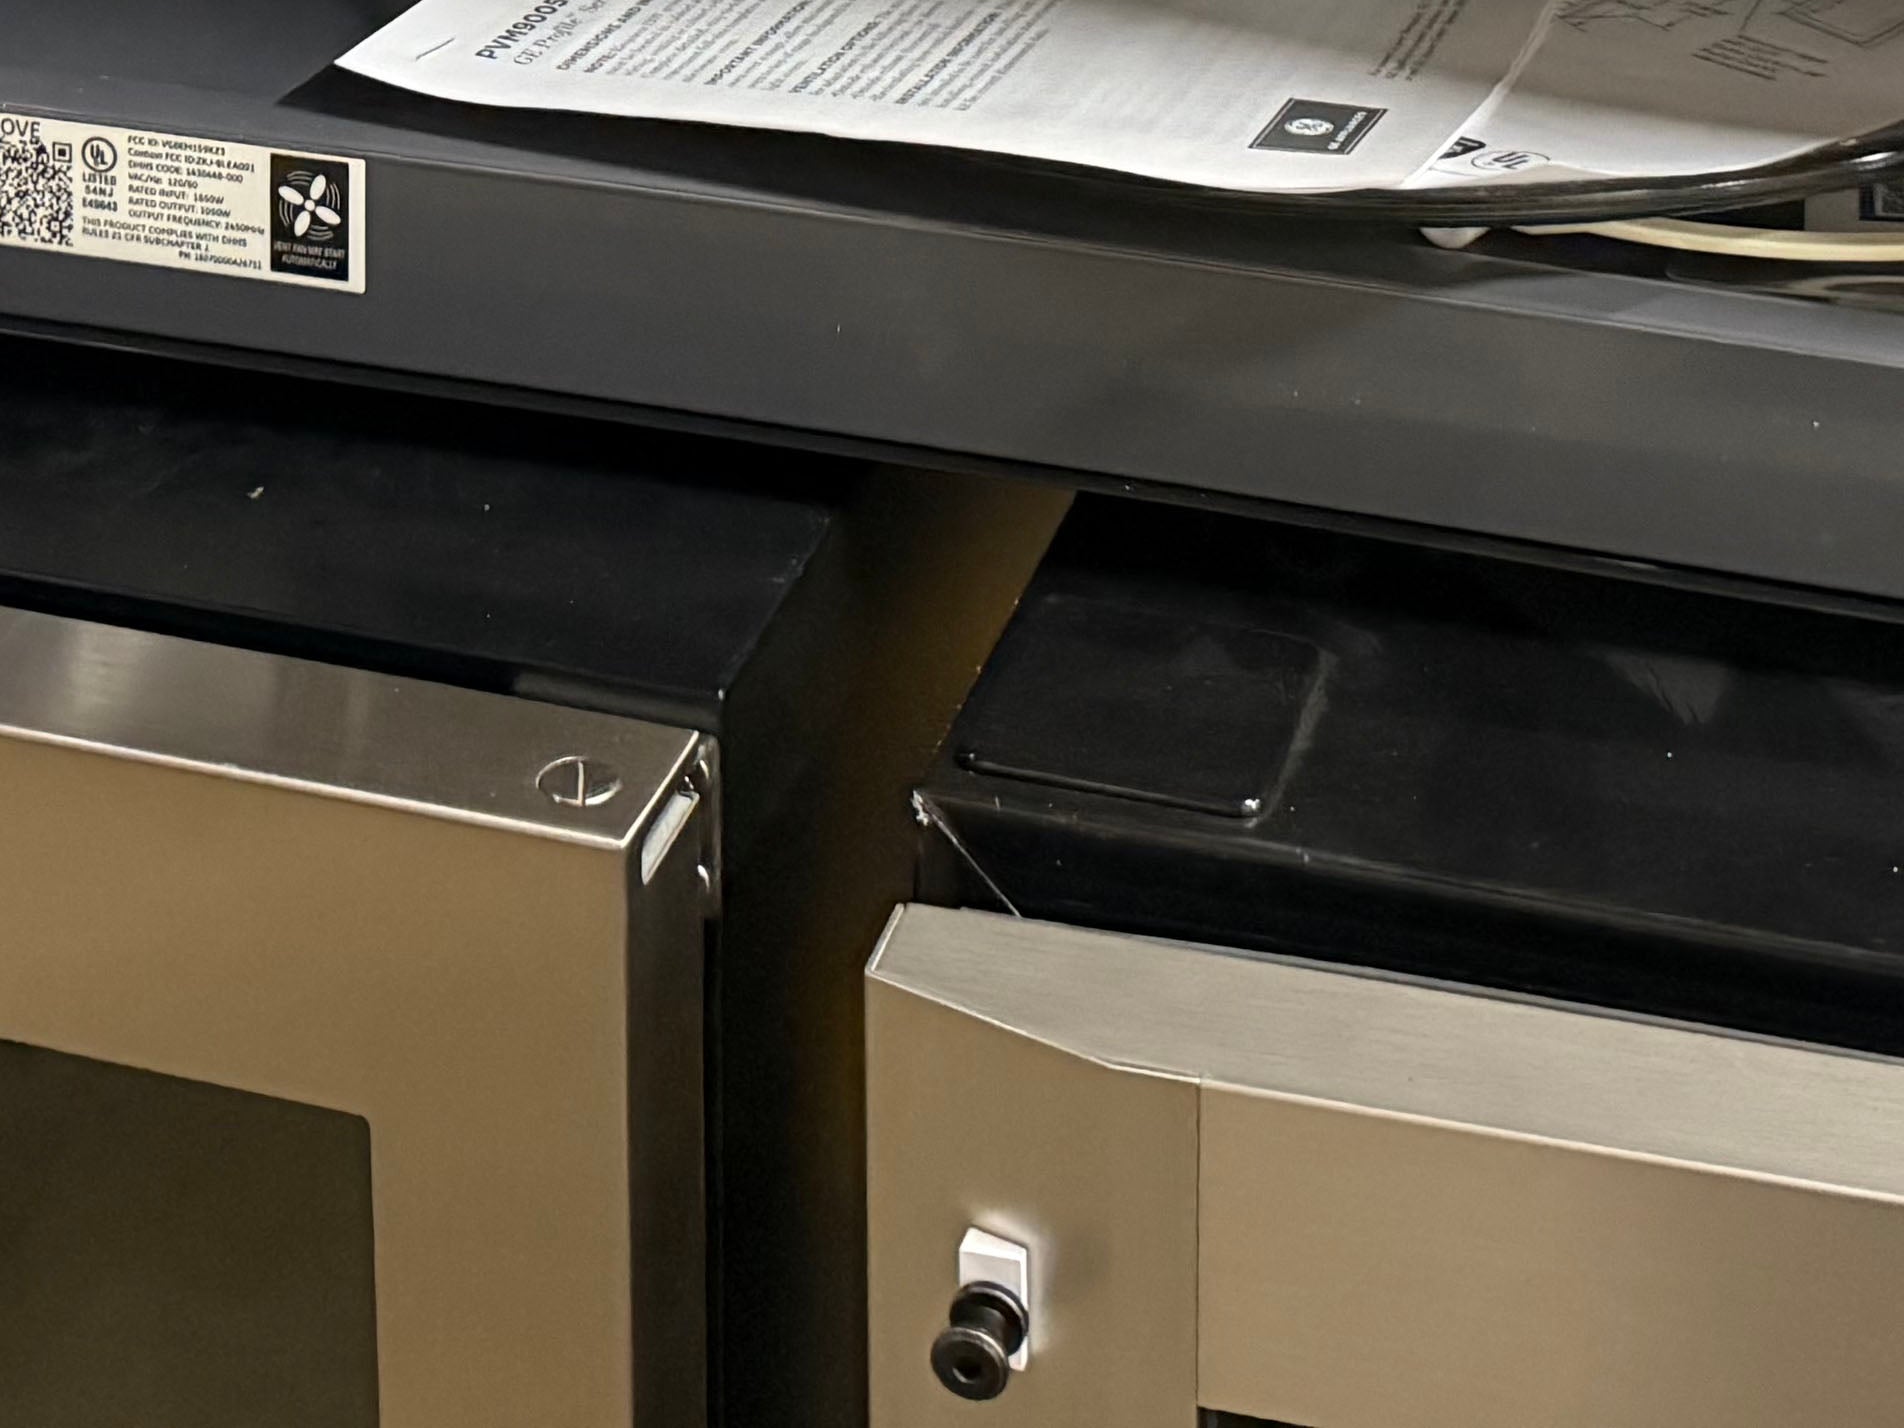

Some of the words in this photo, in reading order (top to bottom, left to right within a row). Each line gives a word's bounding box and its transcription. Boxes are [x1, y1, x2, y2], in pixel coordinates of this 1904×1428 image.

[552, 22, 626, 70] DIMENSIONS
[612, 5, 645, 23] AND
[505, 48, 548, 66] GE
[701, 45, 760, 86] IMPORTANT
[128, 135, 144, 145] FCC
[90, 144, 108, 166] UL
[165, 154, 182, 163] FCC
[82, 172, 117, 186] LISTED
[128, 184, 156, 195] RATED
[128, 196, 156, 208] RATED
[159, 200, 197, 213] OUTPUT:
[128, 209, 164, 221] OUTPUT
[167, 214, 222, 229] FREQUENCY:
[82, 227, 109, 239] RULES
[125, 232, 142, 242] CFR
[144, 235, 201, 251] SUBCHAPTER
[83, 216, 101, 227] THIS
[104, 218, 146, 233] PRODUCT
[148, 224, 193, 239] COMPLIES
[196, 232, 219, 243] WITH
